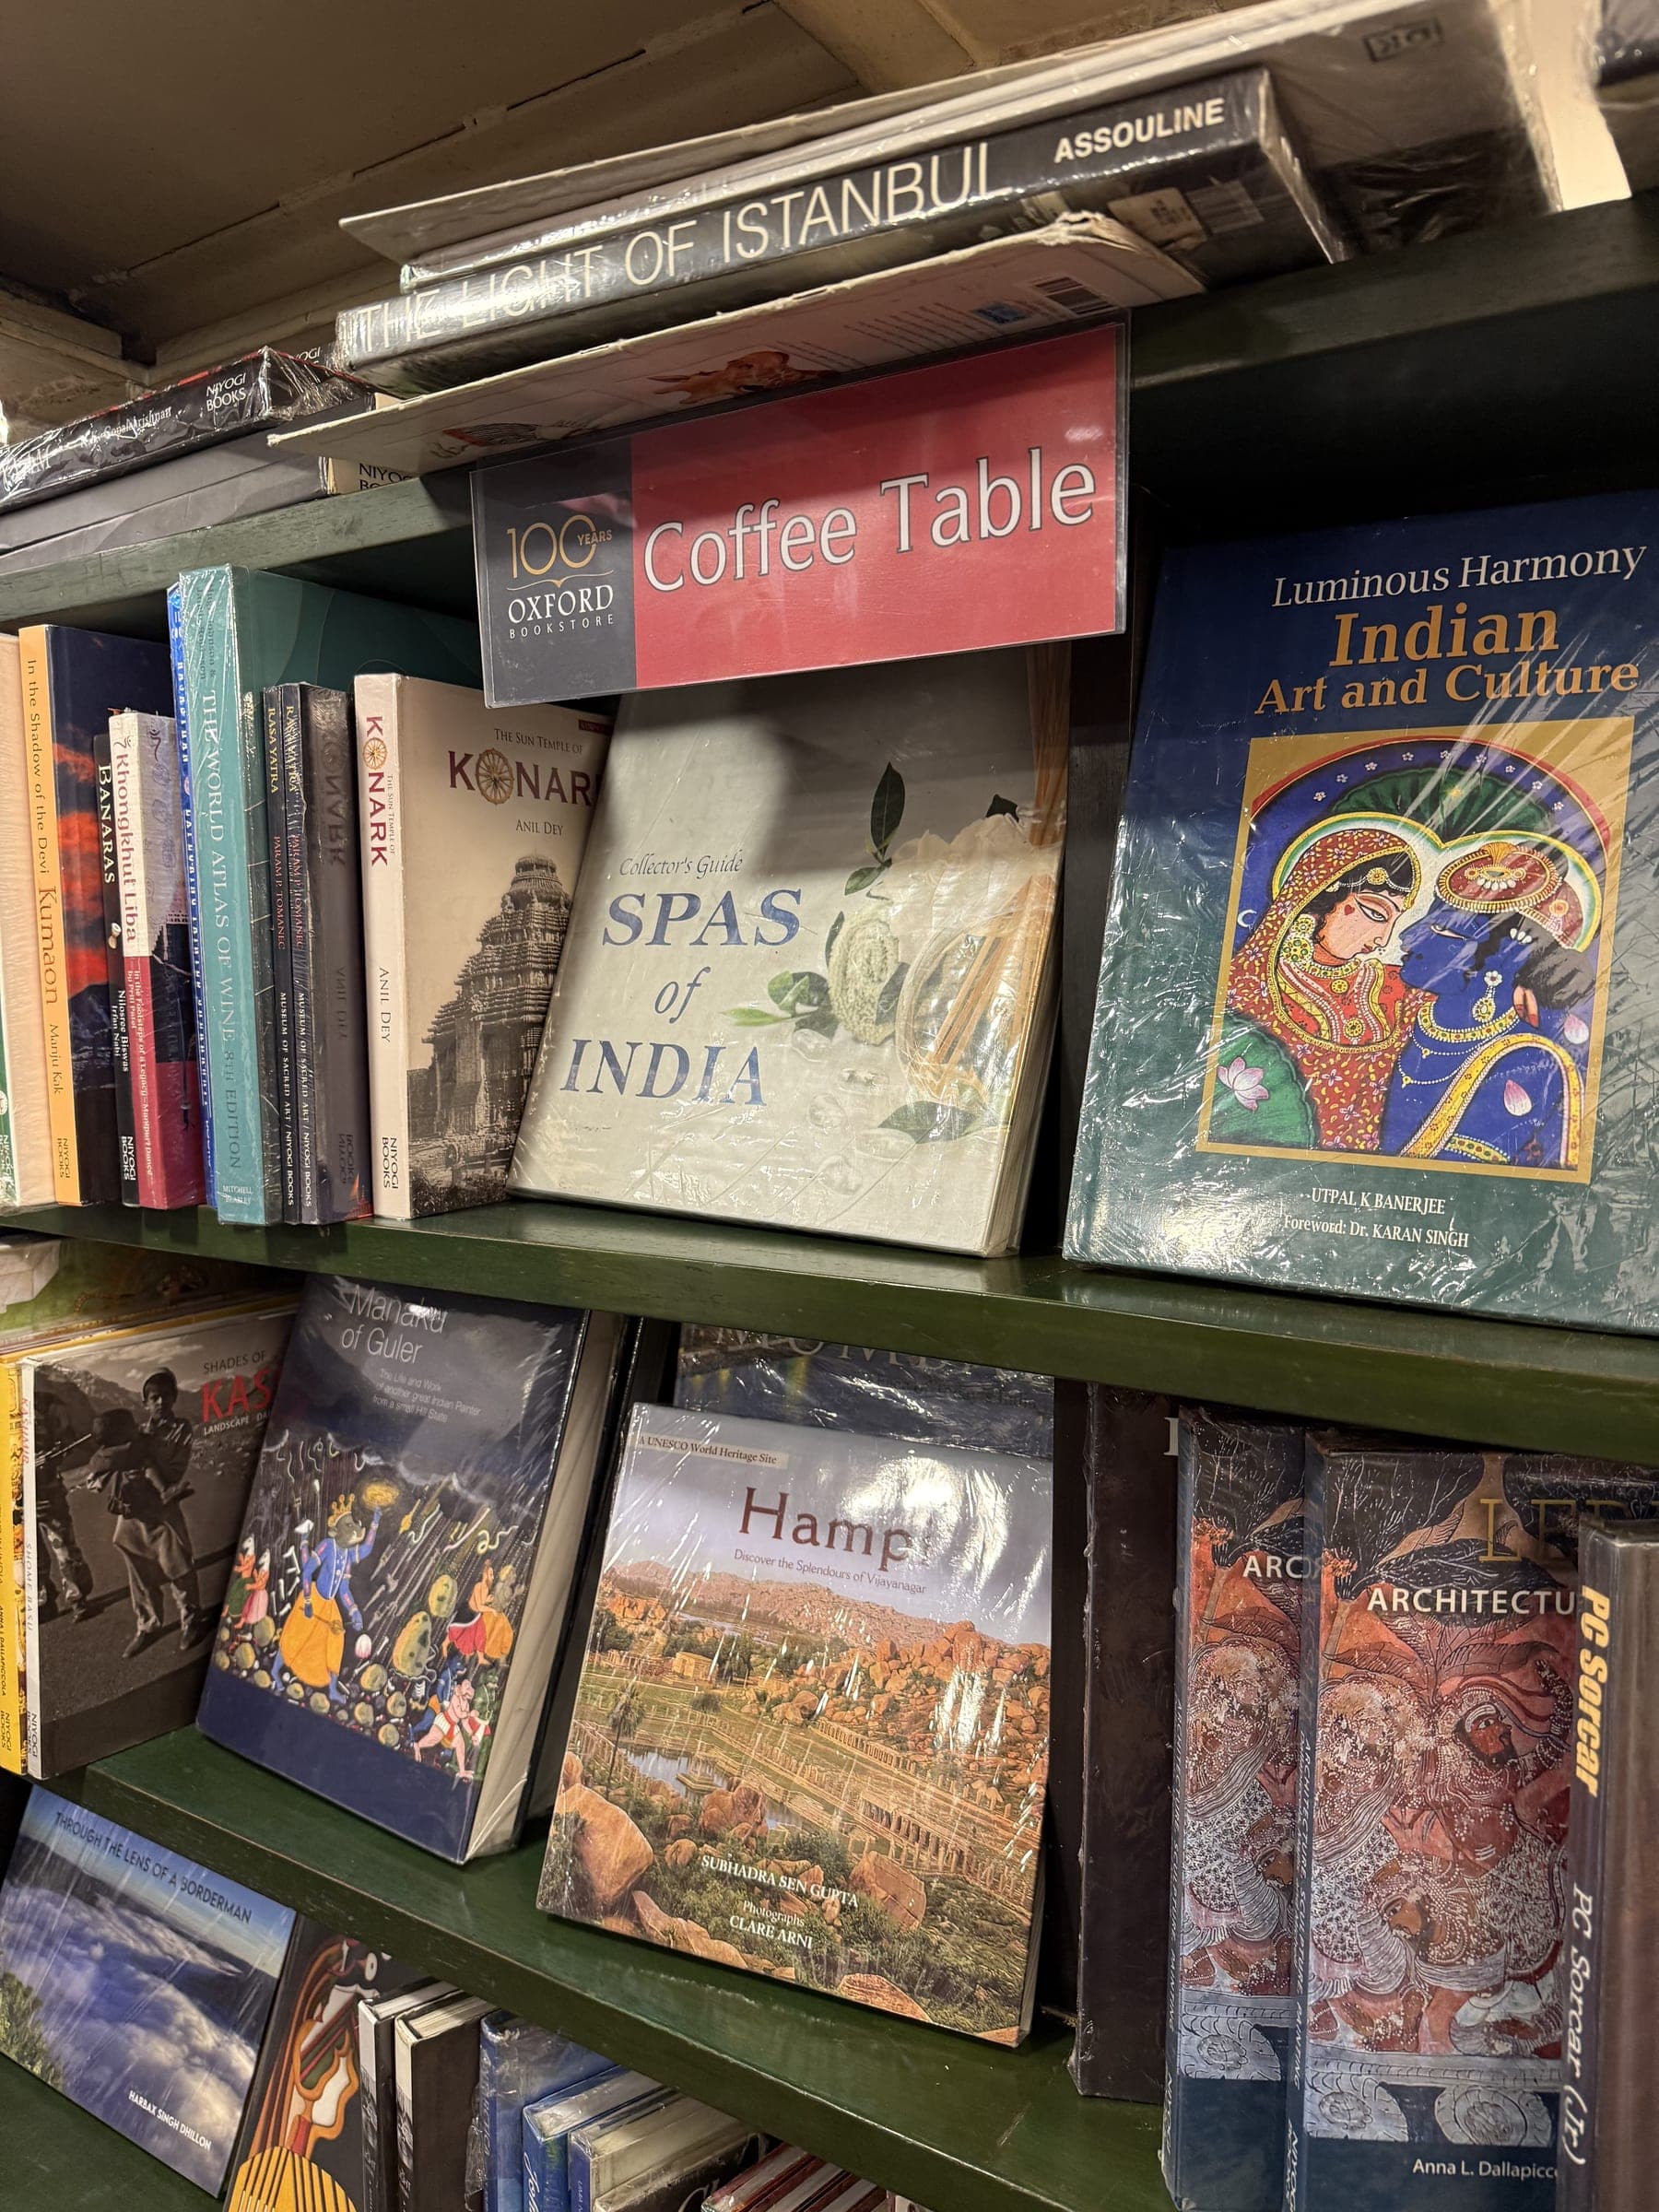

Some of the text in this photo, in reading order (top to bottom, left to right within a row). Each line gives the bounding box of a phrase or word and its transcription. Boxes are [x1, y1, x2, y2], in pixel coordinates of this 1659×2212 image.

[1053, 97, 1226, 165] ASSOULINE
[358, 141, 1014, 353] THE LIGHT OF ISTANBUL
[206, 372, 247, 396] NIYOGI
[206, 387, 247, 412] BOOKS
[507, 515, 595, 578] 100
[577, 530, 612, 546] YEARS
[643, 447, 1096, 593] Coffee Table
[1271, 546, 1647, 607] Luminous Harmony
[509, 584, 613, 623] OXFORD
[510, 614, 614, 639] BOOKSTORE
[1329, 602, 1559, 667] Indian
[1254, 660, 1640, 715] Art and Culture
[203, 689, 218, 742] THE
[493, 728, 512, 742] THE
[515, 730, 535, 745] SUN
[536, 735, 573, 753] TEMPLE
[28, 659, 50, 874] In the Shadow of the Devi
[267, 708, 278, 794] RASA YATRA
[116, 754, 136, 886] Khongkhut
[206, 748, 224, 841] WORLD
[98, 763, 115, 884] BANARAS
[515, 819, 564, 837] ANIL DEY
[211, 851, 229, 928] ATLAS
[619, 853, 744, 878] Collector's Guide
[124, 893, 138, 941] Liba
[274, 836, 285, 950] PARAM TOMANEC
[602, 888, 804, 947] SPAS
[39, 887, 60, 1005] Kumaon
[217, 936, 231, 969] OF
[220, 977, 236, 1041] WINE
[279, 993, 288, 1036] MUSEUM
[298, 993, 306, 1036] MUSEUM
[379, 967, 392, 1043] ANIL DEY
[654, 967, 711, 1025] of
[50, 1023, 61, 1094] Manju Kak
[282, 1040, 288, 1053] OF
[300, 1040, 307, 1053] OF
[559, 1037, 767, 1108] INDIA
[282, 1057, 290, 1097] SACRED
[225, 1089, 241, 1169] EDITION
[285, 1131, 293, 1168] NIYOGI
[121, 1135, 130, 1181] BOOKS
[127, 1135, 136, 1181] NIYOGI
[382, 1135, 391, 1189] BOOKS
[390, 1136, 399, 1189] NIYOGI
[1312, 1188, 1446, 1215] UTPAL K BANERJEE
[1284, 1215, 1468, 1248] Foreword: Dr. KARAN SINGH
[203, 1351, 266, 1374] SHADES OF
[341, 1324, 423, 1364] of Guler
[203, 1417, 250, 1436] LANDSCAPE
[648, 1437, 688, 1451] UNESCO
[691, 1443, 717, 1456] World
[720, 1447, 758, 1464] Heritage
[759, 1453, 777, 1465] Site
[735, 1548, 926, 1595] Discover the Splendours of Vijayanagar
[1576, 1585, 1610, 1797] PC Sorcar
[30, 1712, 39, 1759] NIYOGI
[56, 1812, 252, 1924] THROUGH THE LENS OF A BORDERMAN
[701, 1855, 859, 1908] SUBHADRA SEN GUPTA
[730, 1914, 813, 1949] CLARE ARNI
[743, 1900, 806, 1927] Photographs
[1292, 2001, 1302, 2090] PAINTING
[1561, 1882, 1594, 2166] PC Sorcar (Jr)
[129, 2090, 212, 2150] HARBAX SINGH DHILLON
[1412, 2159, 1474, 2176] Anna L.
